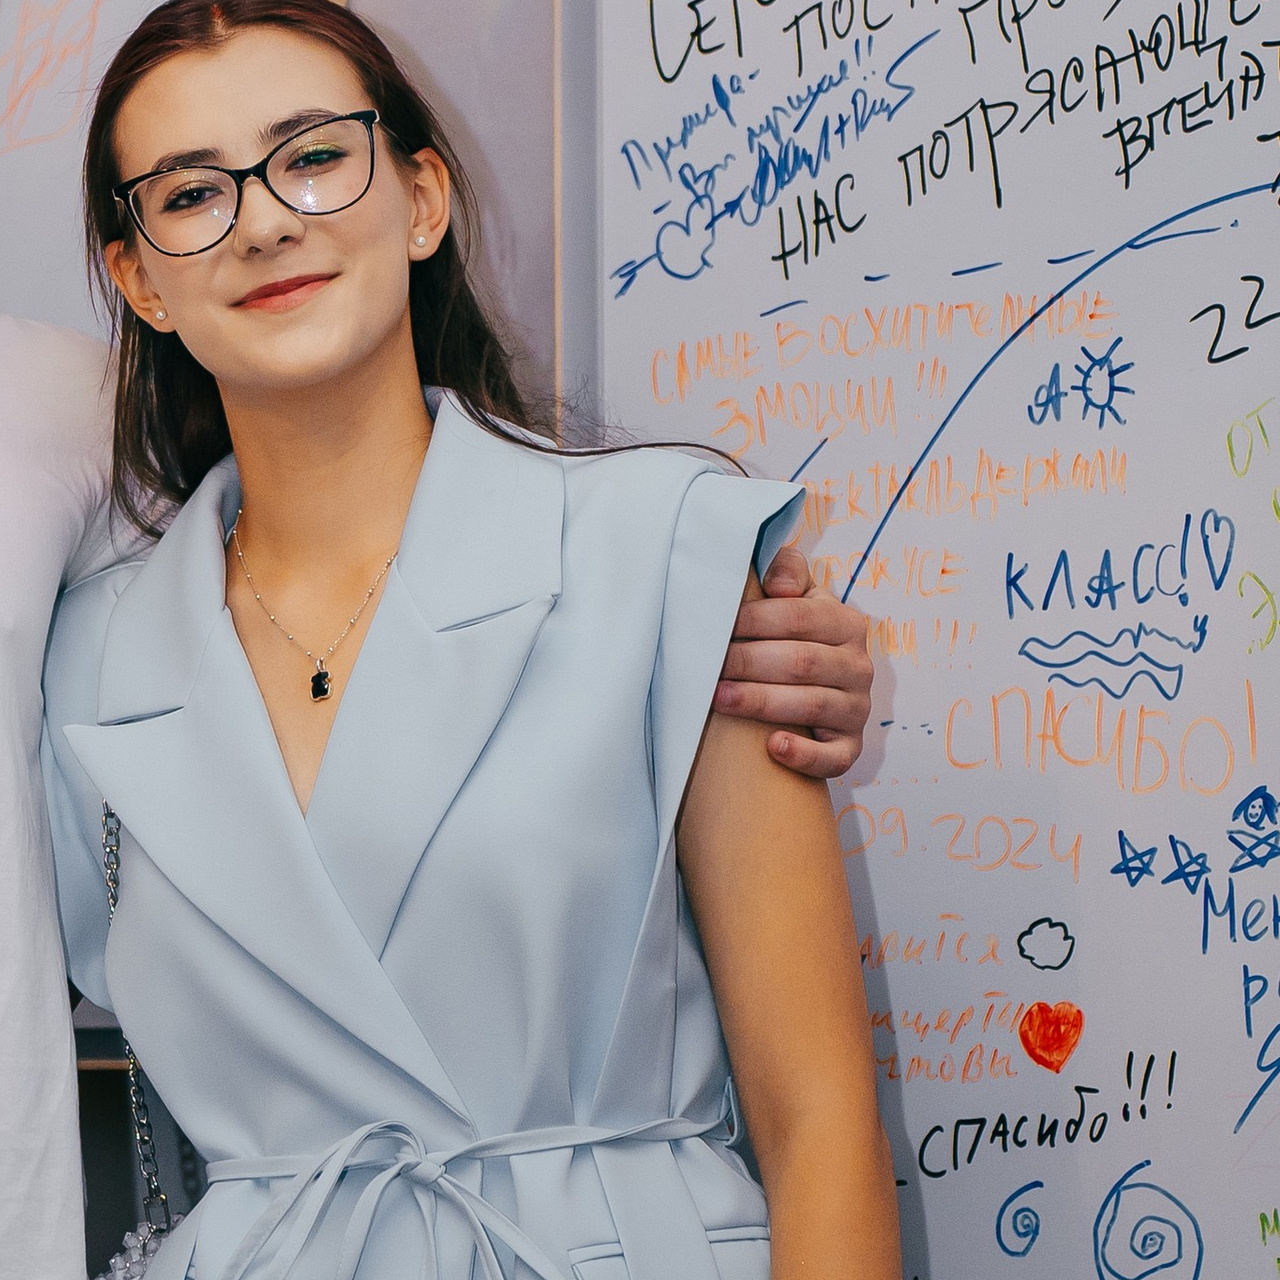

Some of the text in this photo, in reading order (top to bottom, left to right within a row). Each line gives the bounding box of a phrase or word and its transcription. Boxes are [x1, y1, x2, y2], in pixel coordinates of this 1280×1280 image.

[771, 173, 868, 281] НАС
[650, 330, 762, 406] САМЫЕ
[782, 454, 967, 540] ПЕКТАКЛЬ
[1005, 513, 1191, 621] КЛАСС!
